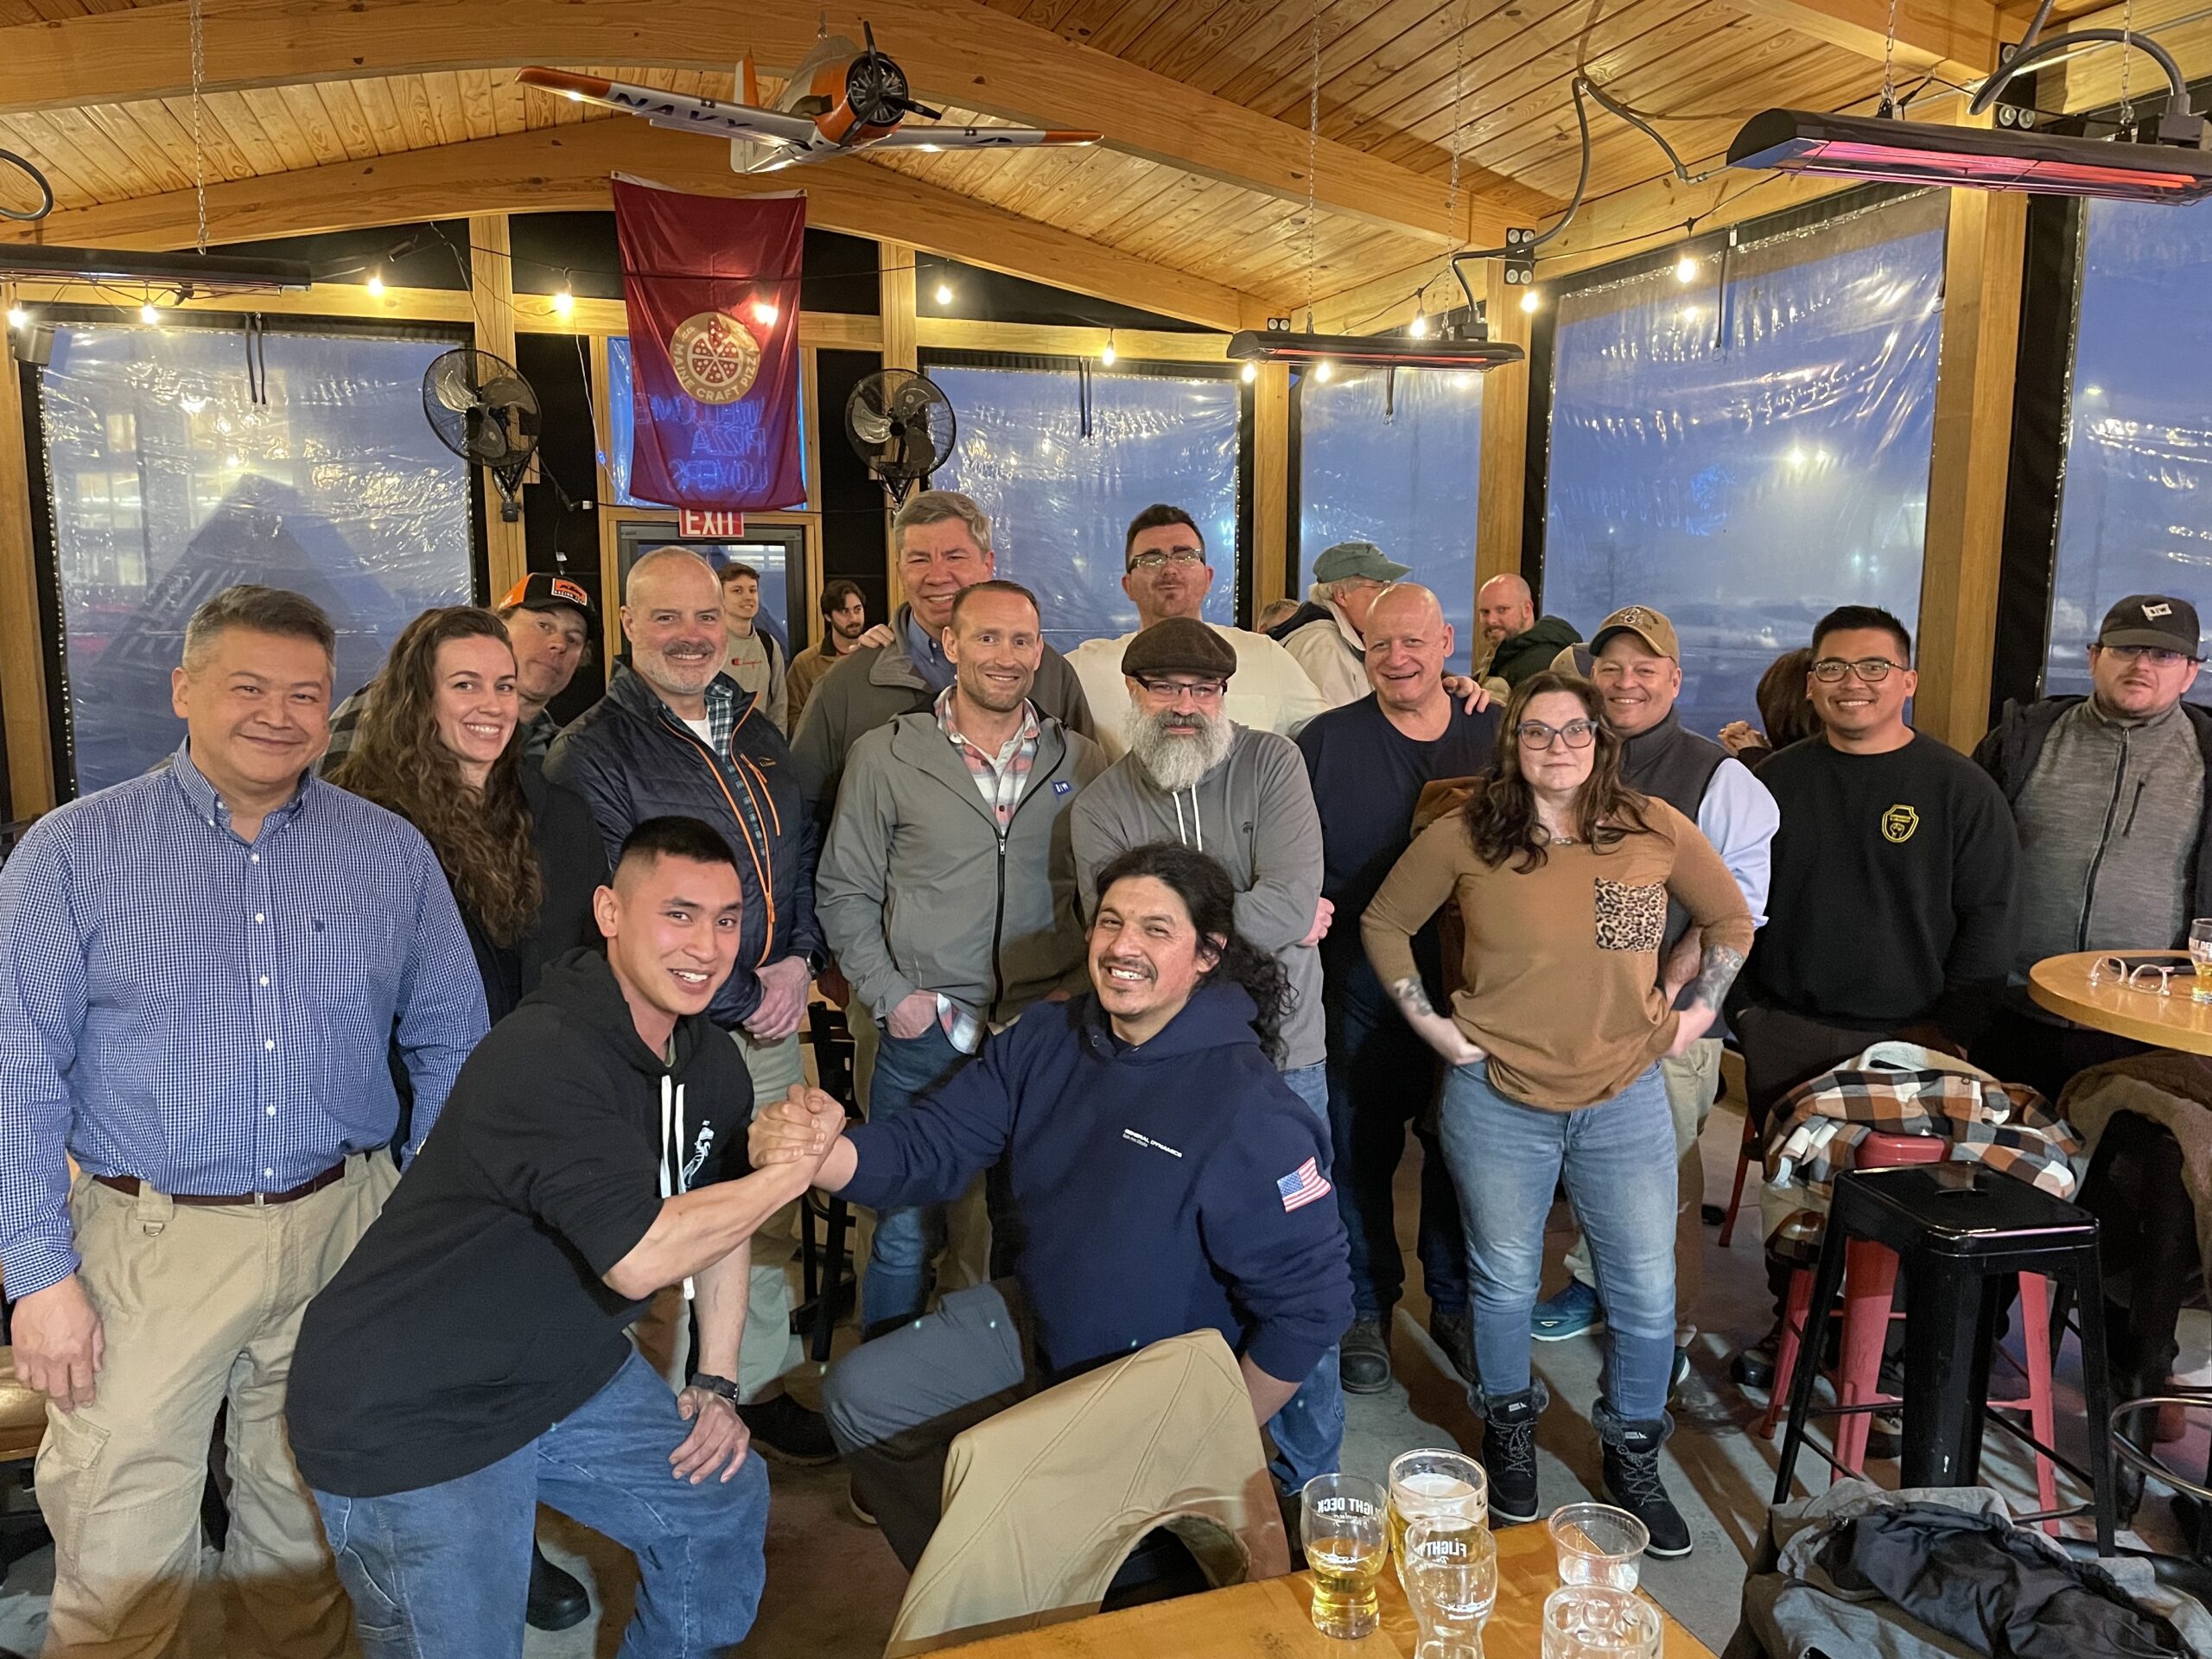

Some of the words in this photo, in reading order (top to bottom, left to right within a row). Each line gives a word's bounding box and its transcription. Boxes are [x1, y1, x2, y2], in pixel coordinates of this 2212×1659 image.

[613, 92, 753, 128] NAVY
[674, 343, 695, 389] MAINE
[696, 385, 741, 401] CRAFT
[685, 508, 734, 535] EXIT
